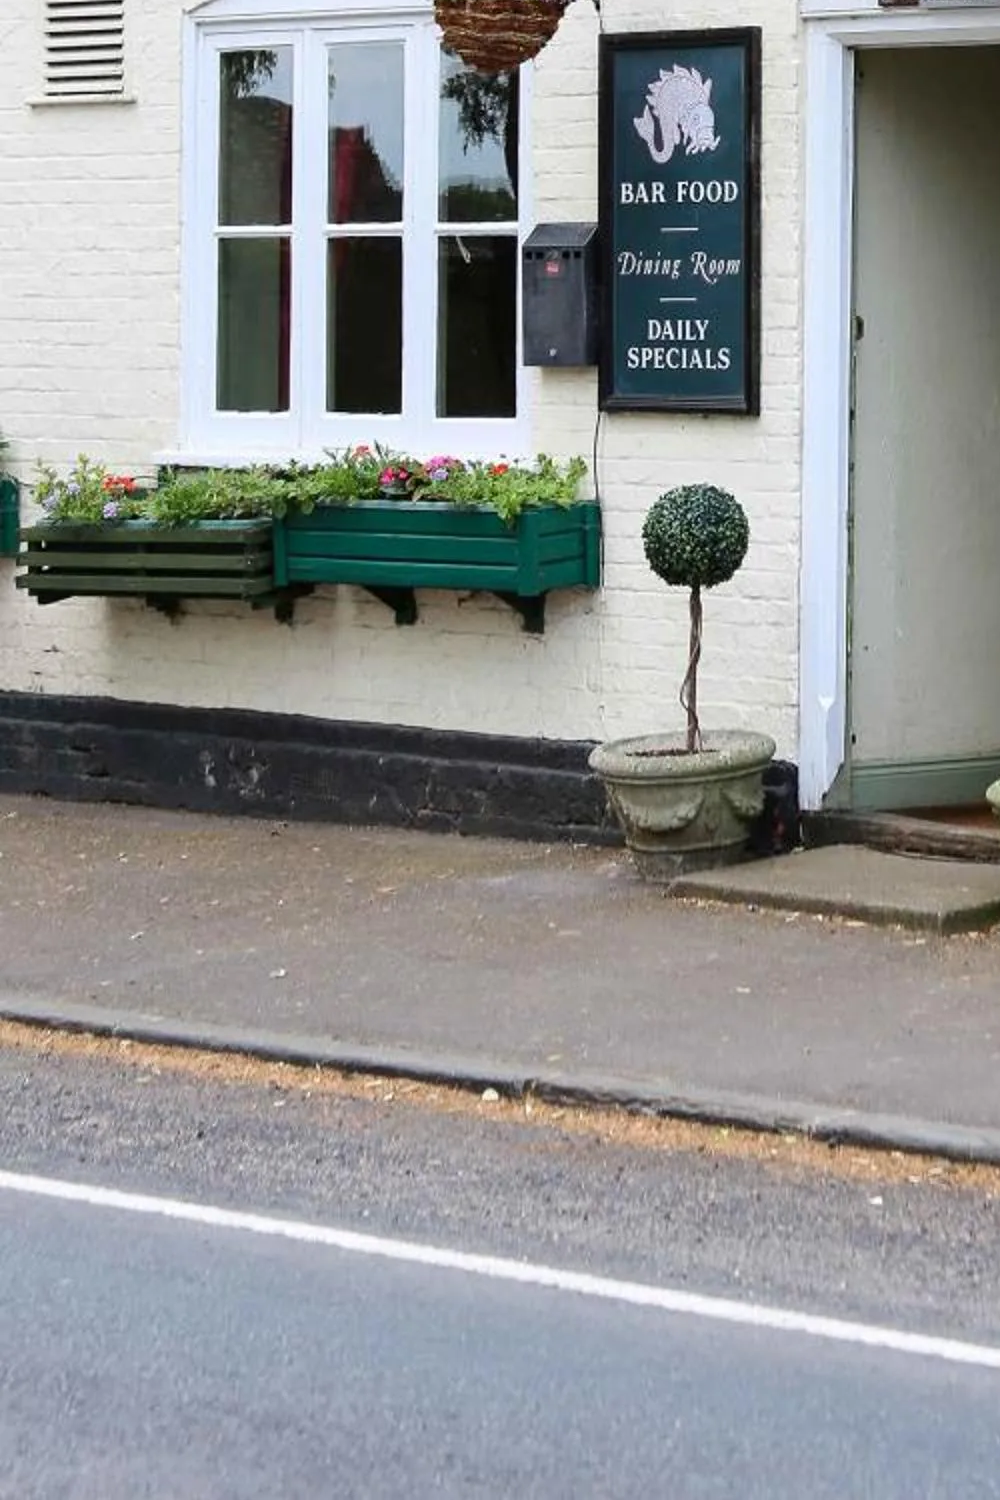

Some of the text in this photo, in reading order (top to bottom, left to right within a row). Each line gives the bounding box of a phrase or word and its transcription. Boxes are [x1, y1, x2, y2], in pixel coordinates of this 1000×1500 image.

[620, 180, 739, 204] BAR FOOD
[617, 251, 741, 284] Dining Room
[648, 319, 709, 341] DAILY
[627, 347, 731, 370] SPECIALS
